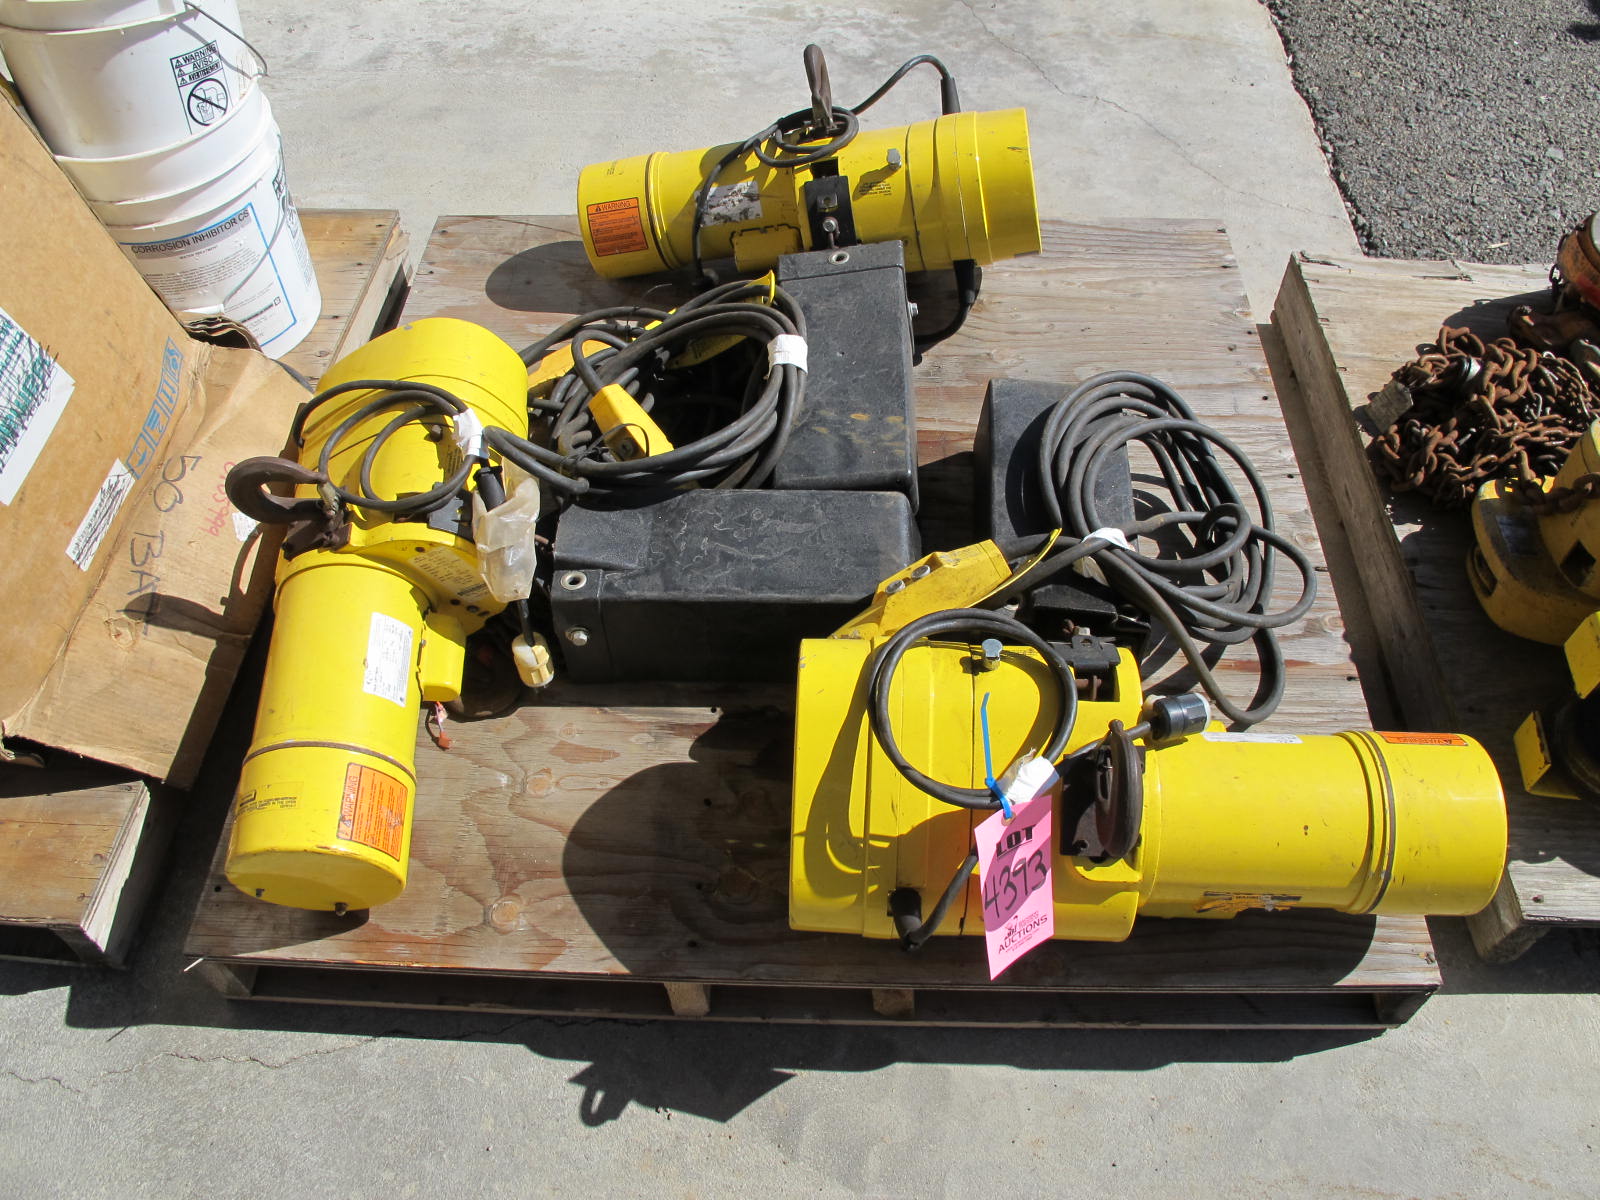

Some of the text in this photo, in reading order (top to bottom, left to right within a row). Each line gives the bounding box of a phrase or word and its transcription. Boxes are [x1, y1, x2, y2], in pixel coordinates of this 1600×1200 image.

[182, 43, 217, 64] WARNING
[192, 56, 214, 70] AVISO
[601, 201, 632, 211] WARNING
[131, 209, 250, 254] CORROSION INHIBITOR CS
[343, 775, 358, 818] WARNING
[996, 824, 1036, 857] LOT
[984, 850, 1048, 918] 4393
[998, 915, 1048, 954] AUCTIONS
